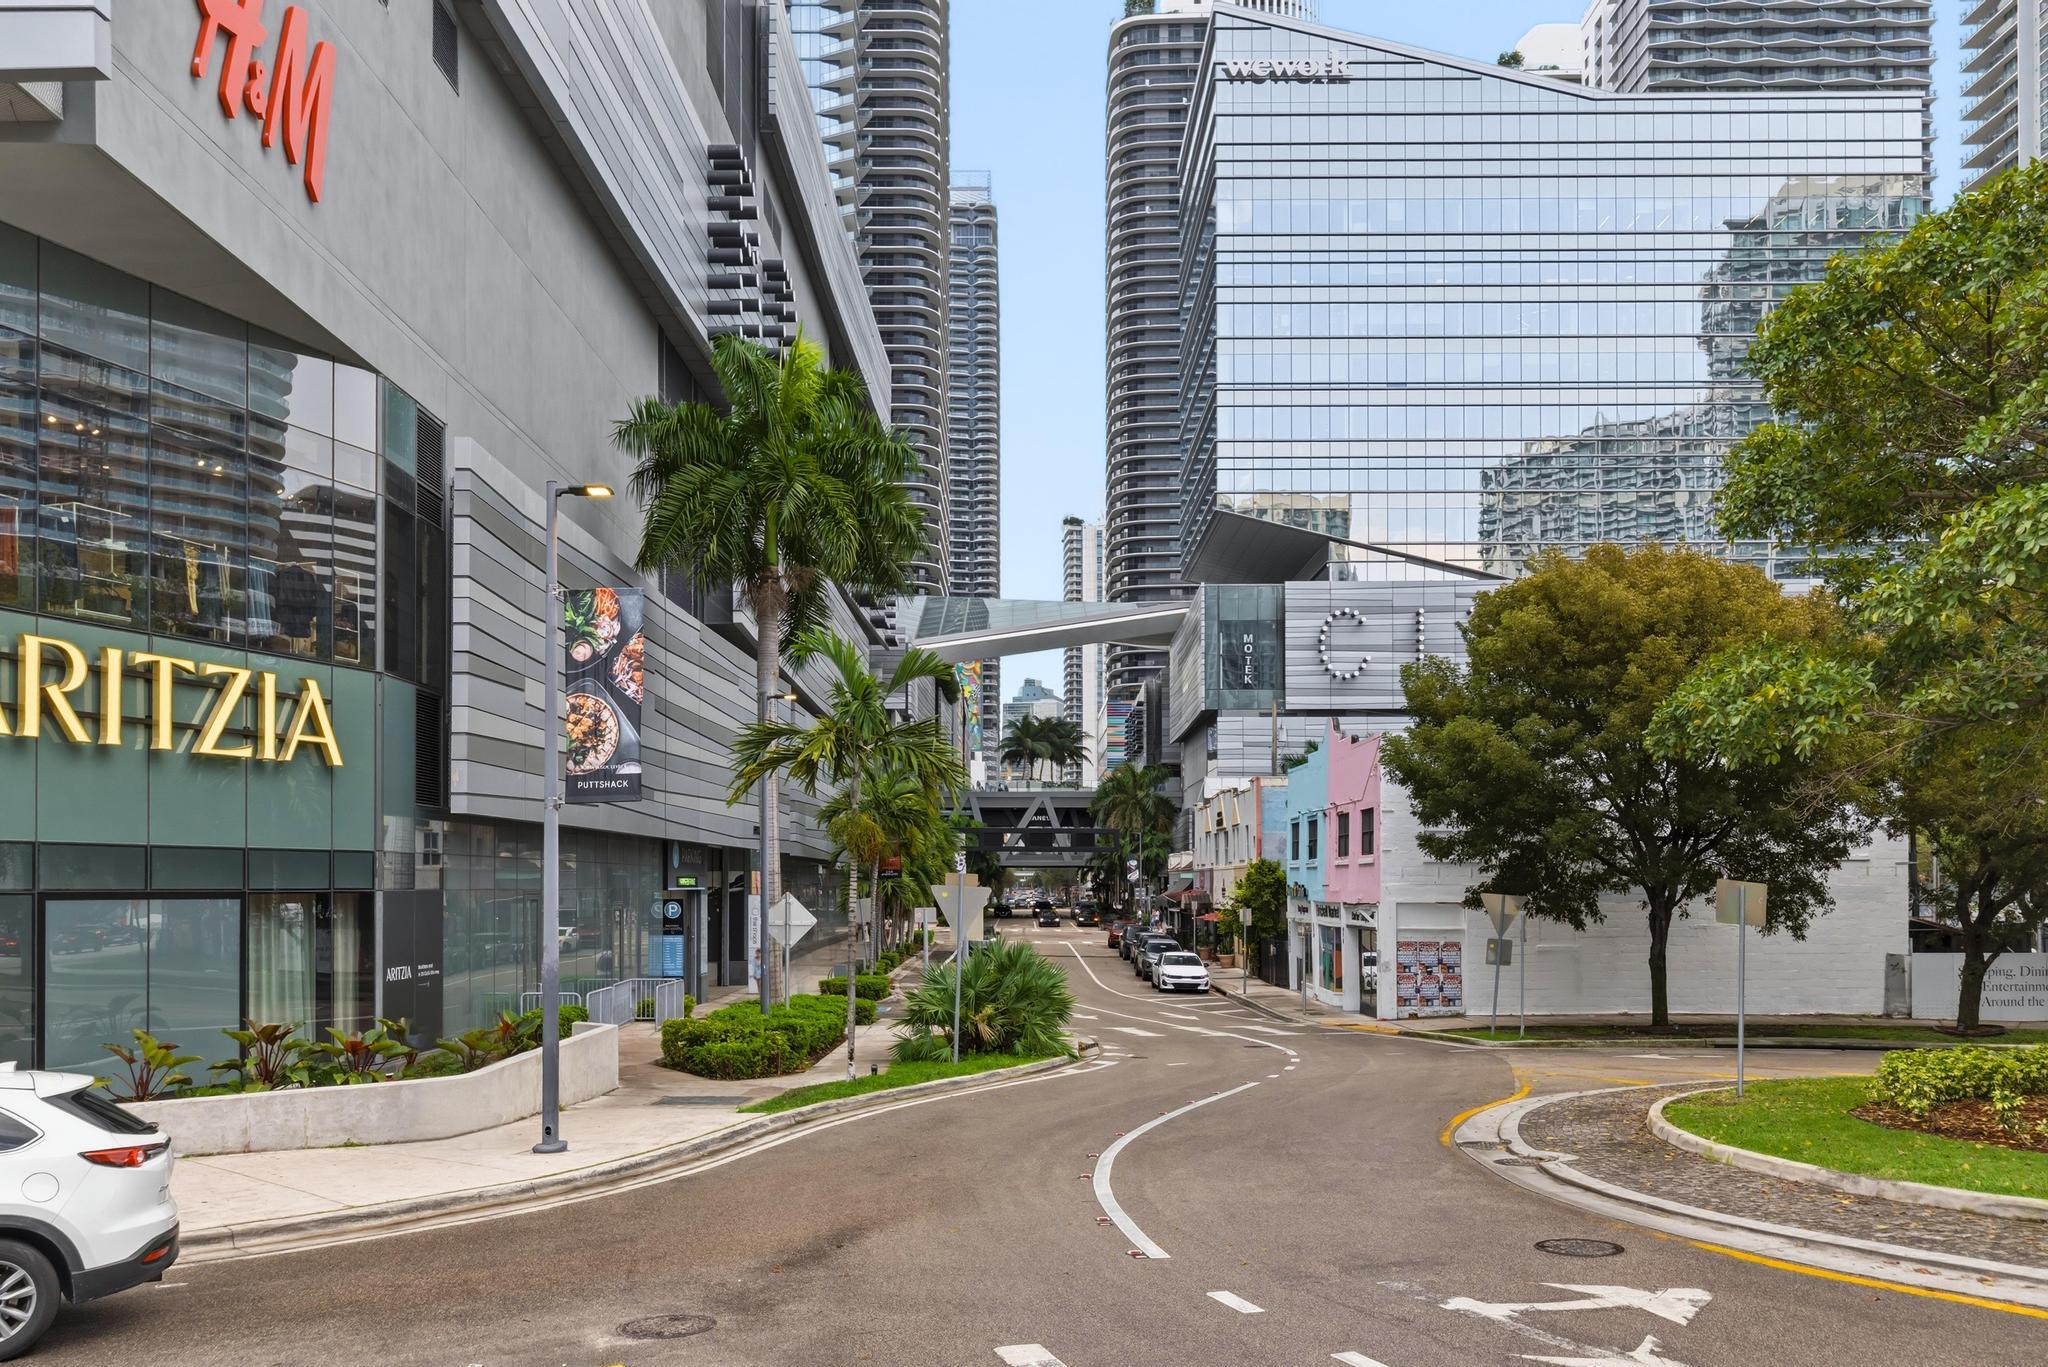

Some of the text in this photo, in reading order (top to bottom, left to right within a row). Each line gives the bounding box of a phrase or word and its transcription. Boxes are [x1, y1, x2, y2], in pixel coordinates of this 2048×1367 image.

[1225, 50, 1351, 77] wework
[191, 0, 337, 204] H&M
[1243, 633, 1254, 684] MOTEK
[0, 632, 344, 767] RITZIA
[577, 780, 629, 789] PUTTSHACK
[386, 965, 412, 982] ARITZIA
[1982, 996, 2045, 1008] Around the
